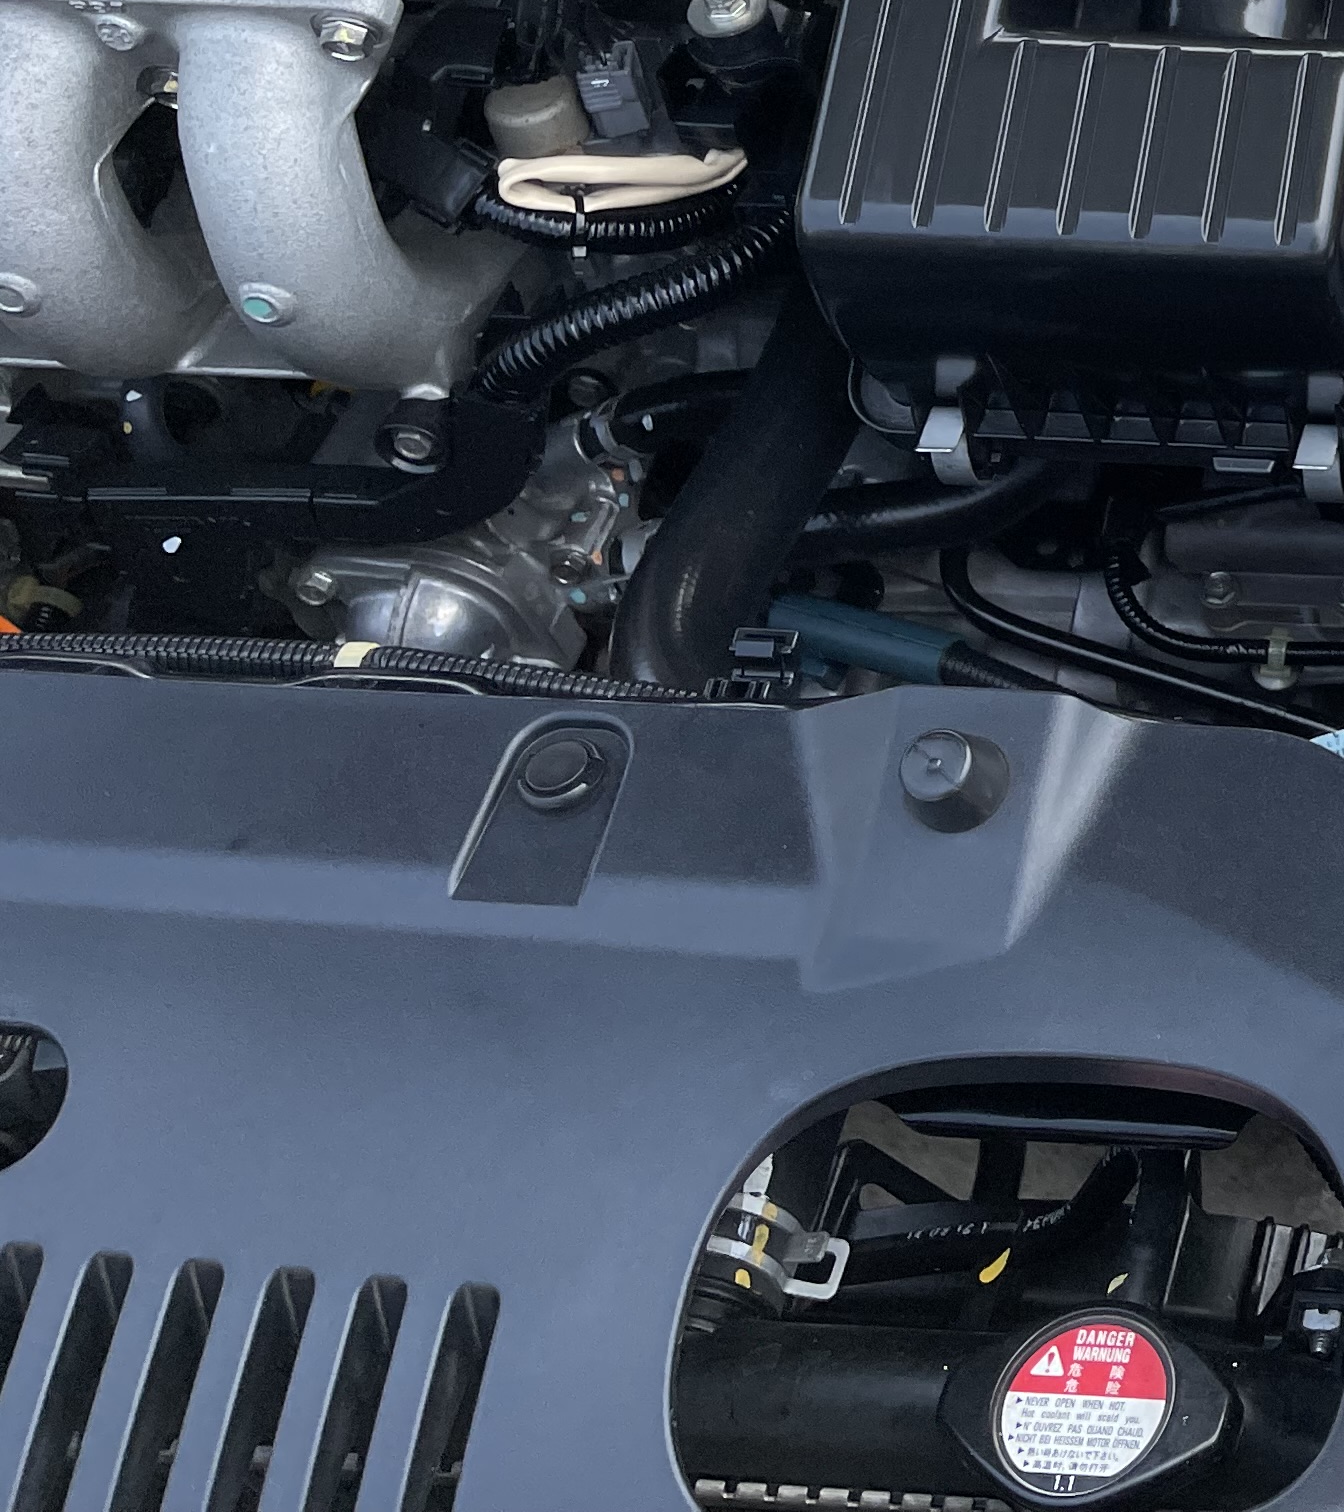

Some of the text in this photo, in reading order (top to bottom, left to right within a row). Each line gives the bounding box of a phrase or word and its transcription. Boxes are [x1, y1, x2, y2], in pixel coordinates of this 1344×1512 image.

[1076, 1329, 1136, 1347] DANGER
[1072, 1346, 1132, 1364] WARNUNG
[1024, 1396, 1126, 1411] NEVER OPEN WHEN HOT.
[1021, 1408, 1140, 1425] Hot coolant will scald you.
[1034, 1423, 1063, 1433] OUVREZ
[1067, 1424, 1082, 1434] PAS
[1086, 1425, 1114, 1436] QUAND
[1015, 1434, 1038, 1443] NICHT
[1039, 1434, 1052, 1444] BEI
[1054, 1436, 1084, 1446] HEISSEM
[1086, 1437, 1110, 1448] MOTOR
[1054, 1475, 1076, 1491] 1.1
